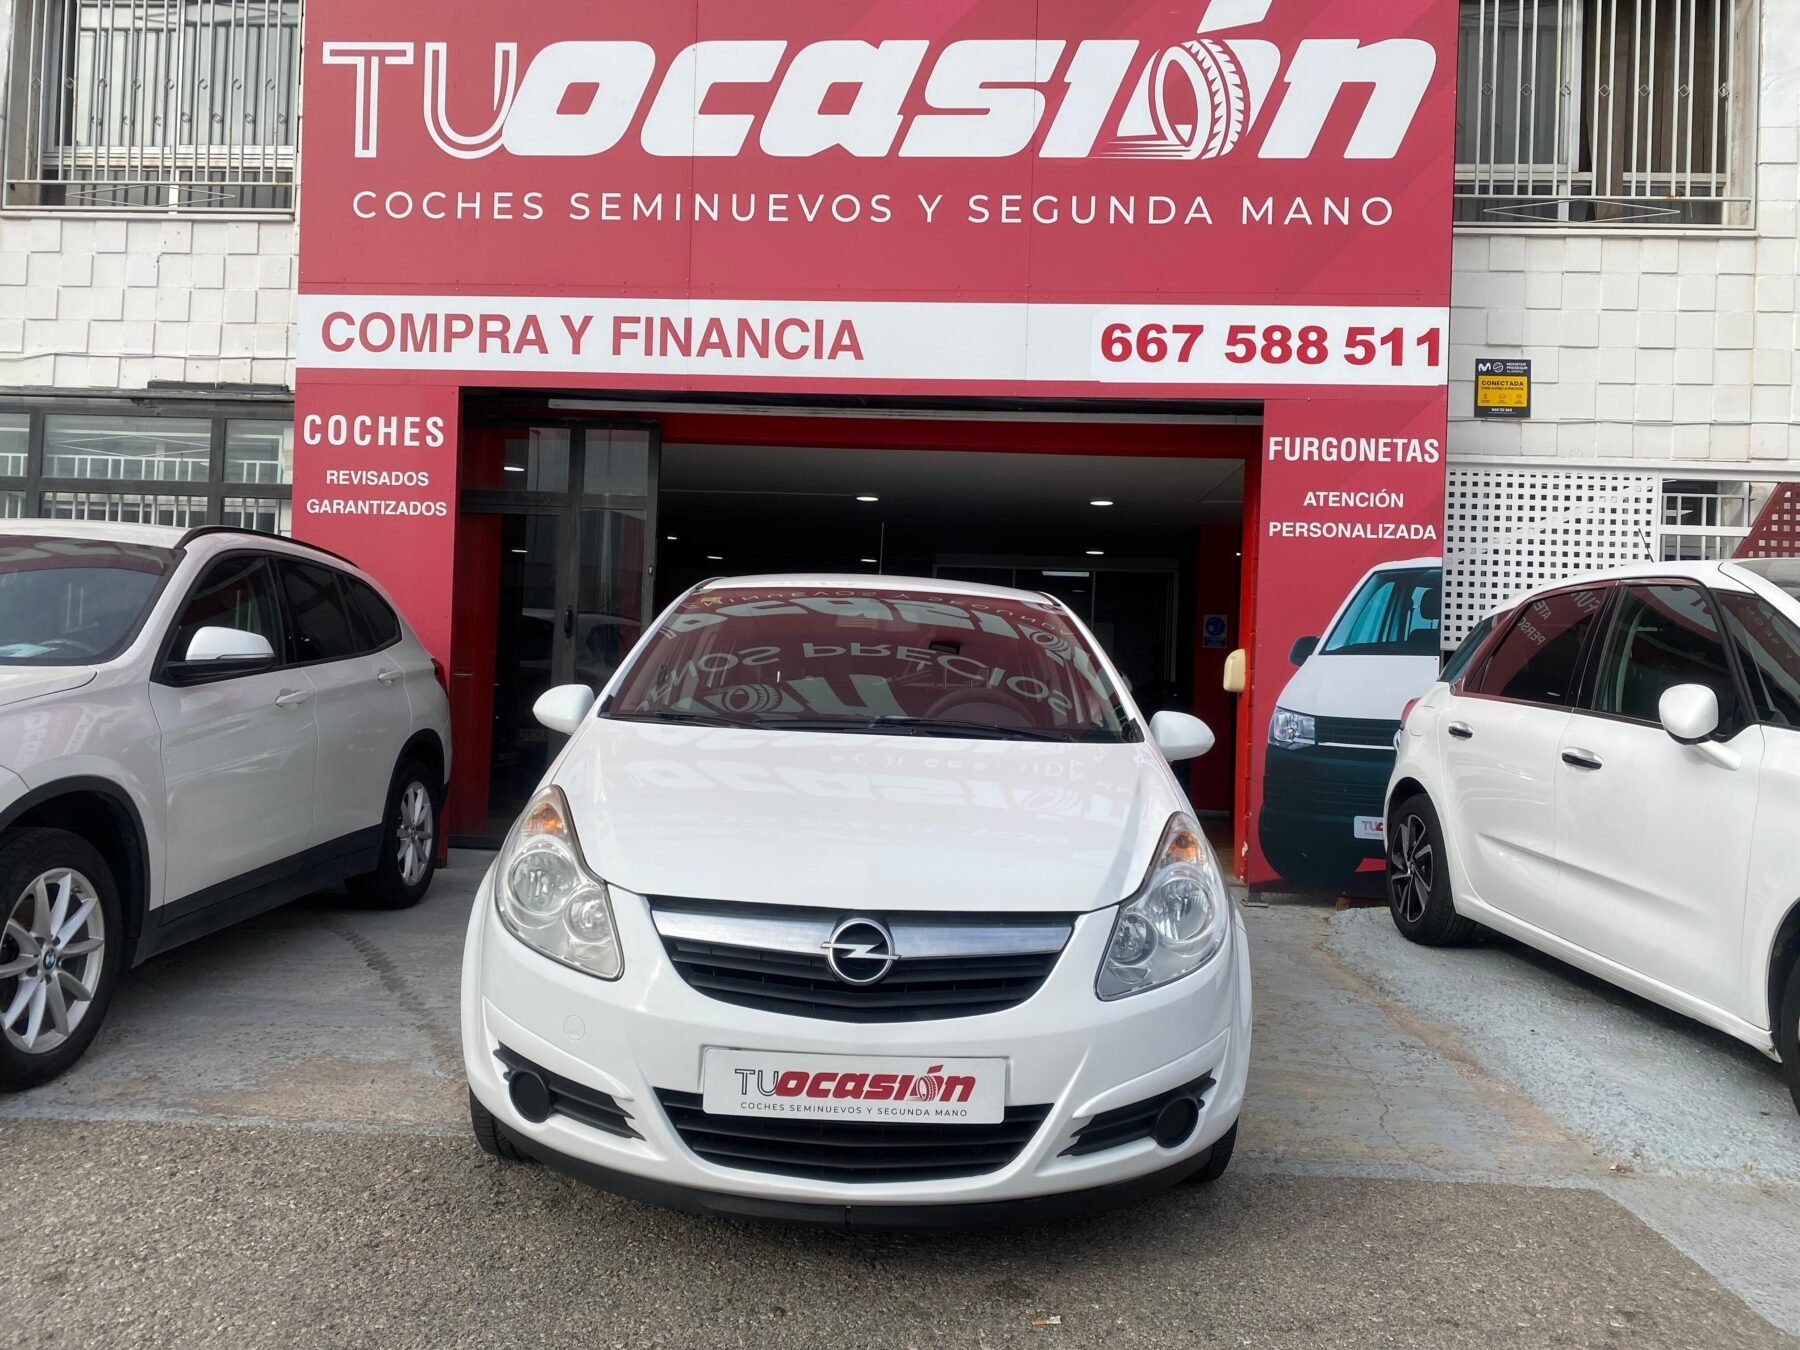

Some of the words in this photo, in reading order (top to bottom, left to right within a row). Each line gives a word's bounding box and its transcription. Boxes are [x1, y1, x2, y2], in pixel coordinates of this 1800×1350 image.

[352, 190, 544, 220] COCHES
[569, 192, 892, 223] SEMINUEVOS
[917, 194, 943, 223] Y
[968, 194, 1213, 225] SEGUNDA
[1242, 196, 1393, 226] MANO
[321, 311, 549, 355] COMPRA
[560, 314, 594, 355] Y
[612, 315, 865, 361] FINANCIA
[1100, 322, 1204, 363] 667
[1224, 324, 1329, 365] 588
[1343, 326, 1440, 367] 511
[303, 414, 444, 448] COCHES
[1268, 436, 1440, 464] FURGONETAS
[326, 469, 429, 487] REVISADOS
[306, 498, 447, 517] GARANTIZADOS
[1303, 488, 1404, 508] ATENCIÓN
[1268, 521, 1437, 540] PERSONALIZADA
[740, 1101, 785, 1112] COCHES
[789, 1104, 862, 1115] SEMINUEVOS
[866, 1107, 873, 1115] Y
[877, 1107, 930, 1117] SEGUNDA
[934, 1109, 968, 1117] MANO
